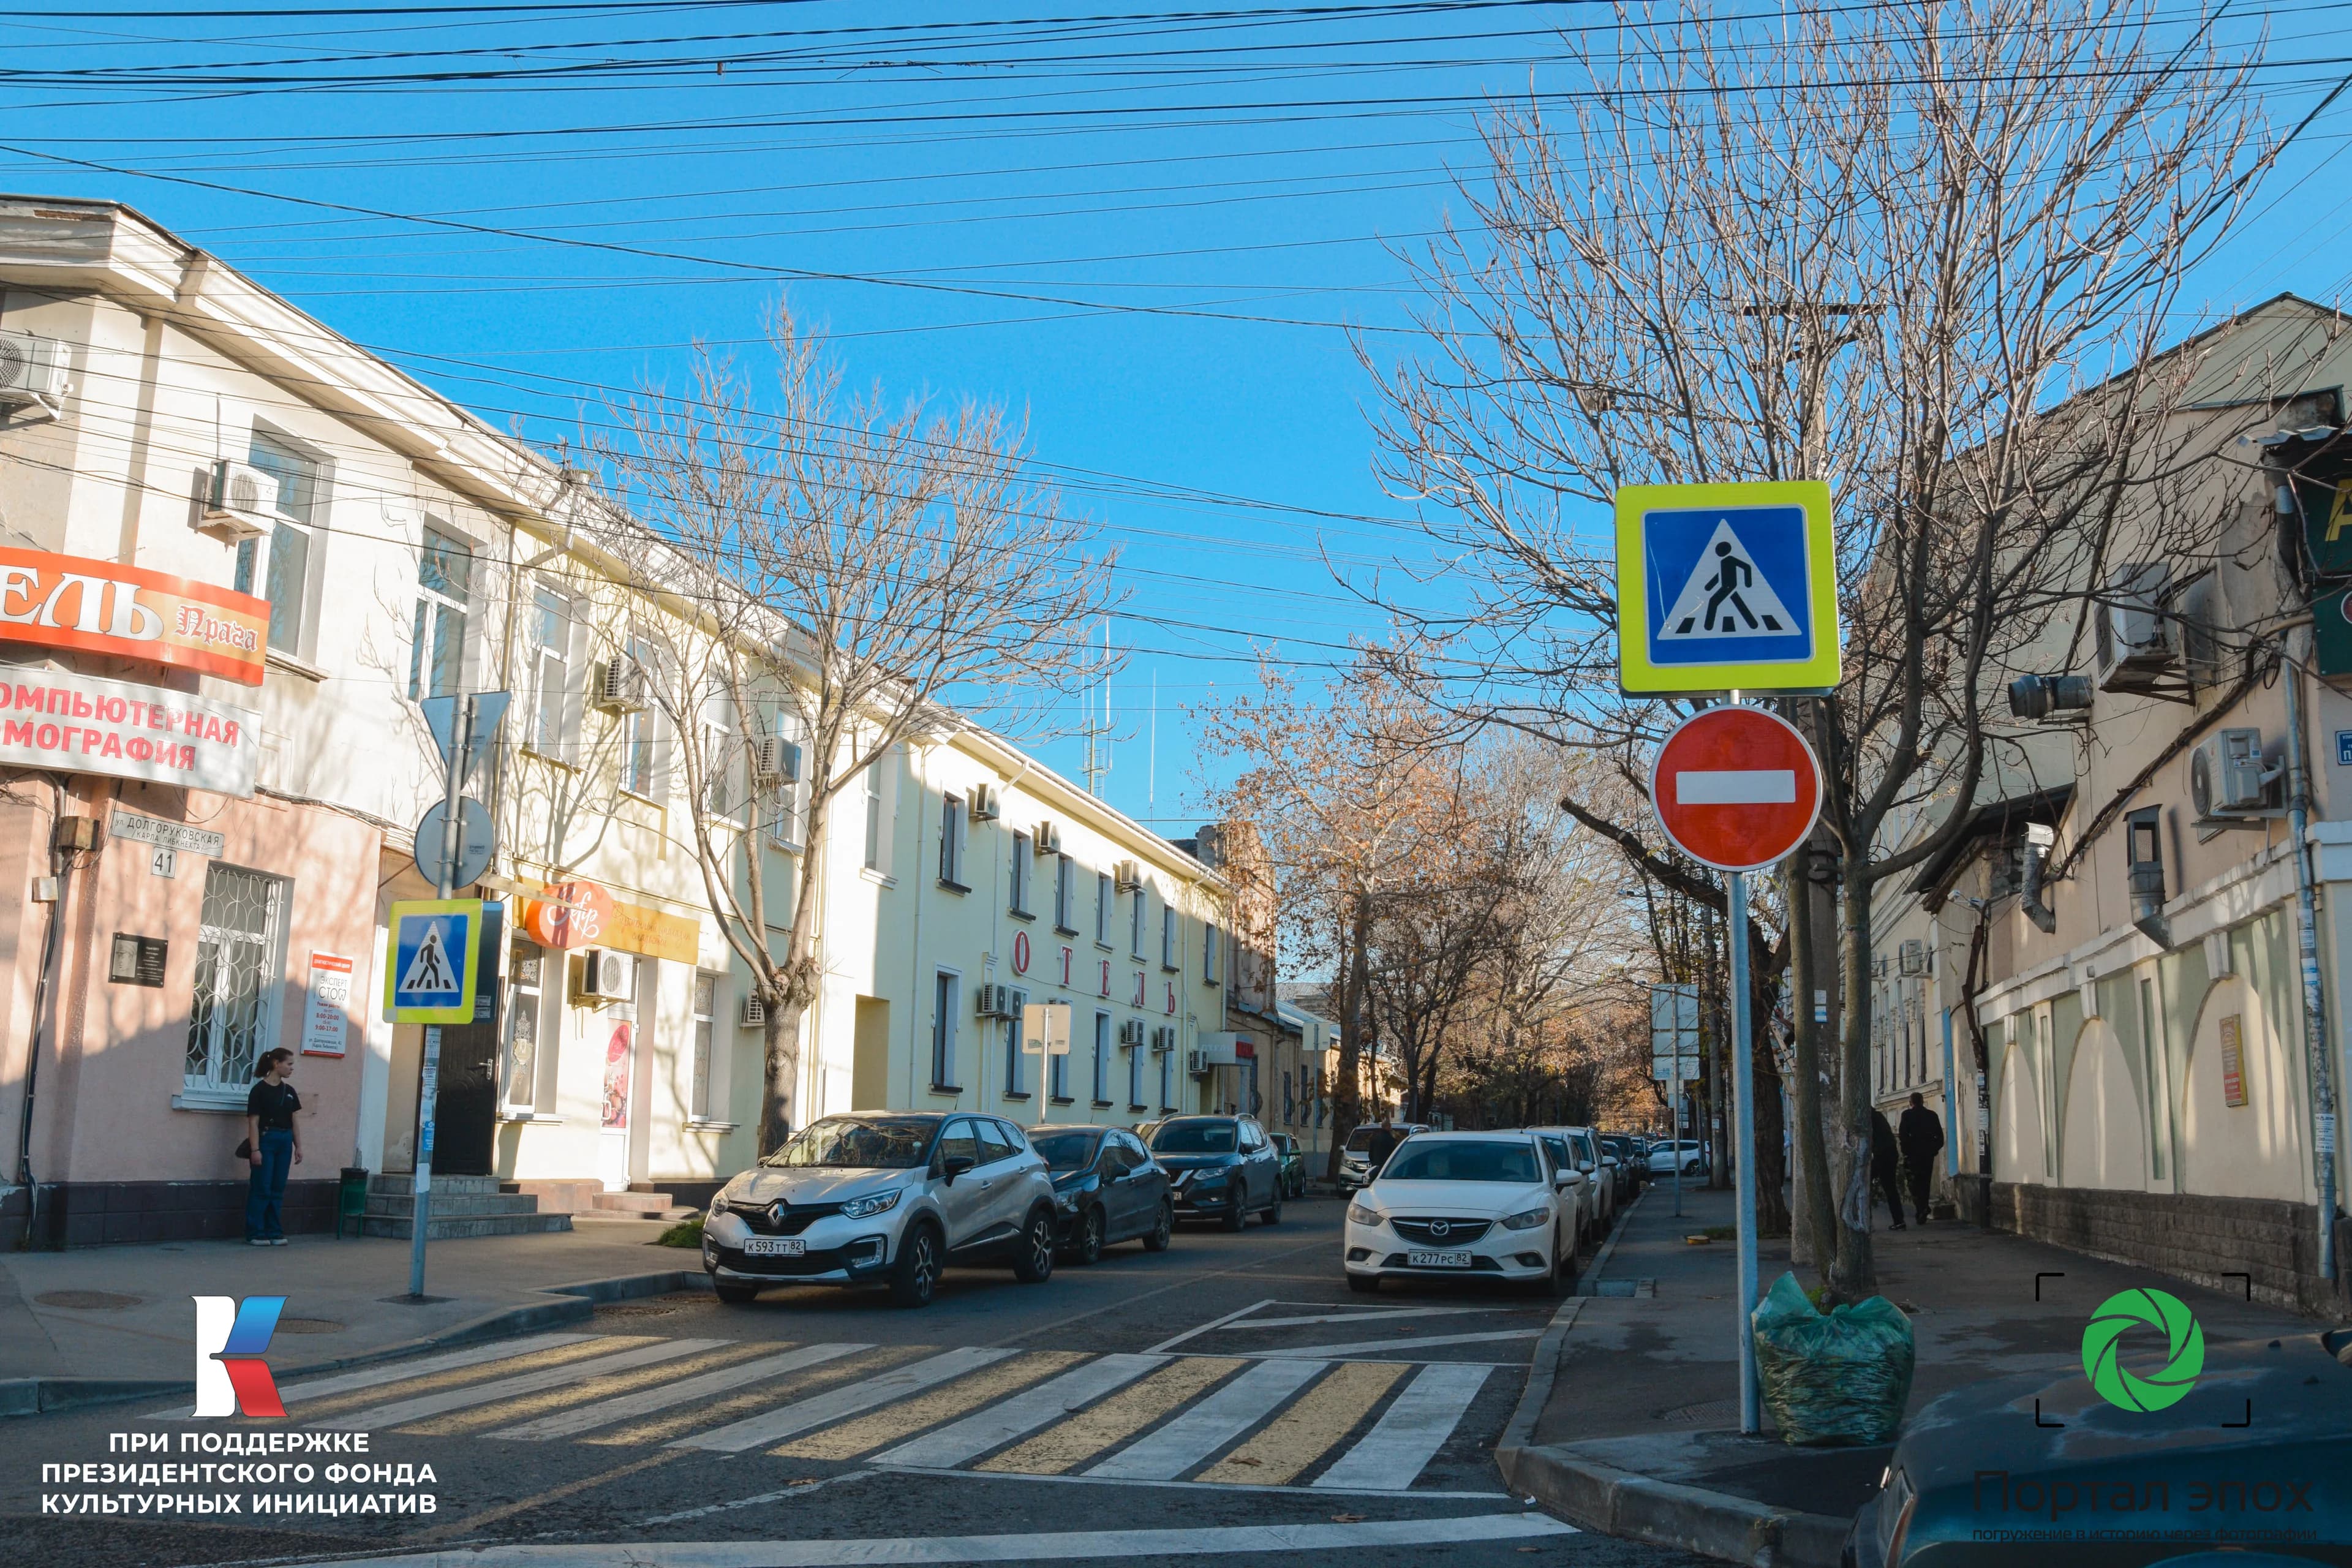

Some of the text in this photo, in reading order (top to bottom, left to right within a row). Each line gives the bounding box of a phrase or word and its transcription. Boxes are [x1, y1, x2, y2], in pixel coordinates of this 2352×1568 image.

[0, 564, 258, 651] ЕЛЬ Прага
[0, 719, 196, 771] МОГРАФИЯ
[127, 817, 220, 846] ДОЛГОРУКОВСКАЯ
[154, 853, 172, 873] 41
[320, 976, 347, 987] ЭКСПЕРТ
[1014, 930, 1175, 1014] ОТЕЛЬ
